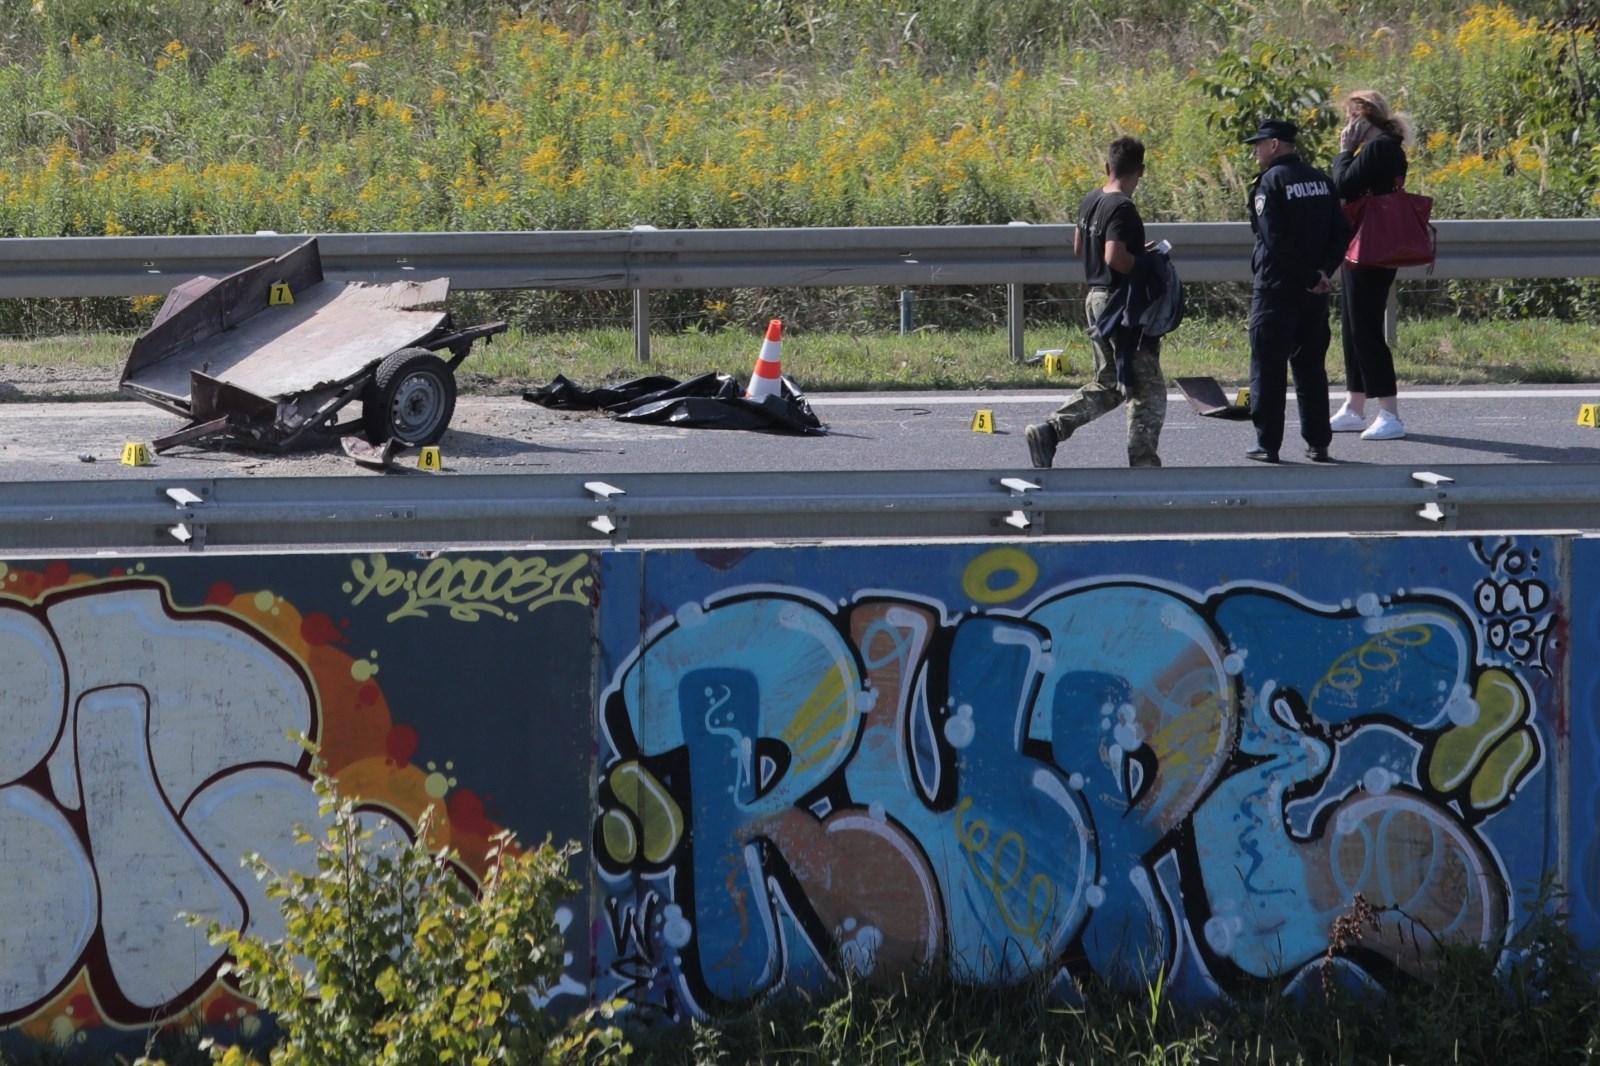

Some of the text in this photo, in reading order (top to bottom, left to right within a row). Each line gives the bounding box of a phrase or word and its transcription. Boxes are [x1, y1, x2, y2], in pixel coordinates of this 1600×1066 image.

[1286, 181, 1329, 200] POLICIJA
[276, 288, 283, 302] 7
[1057, 358, 1063, 373] 4
[978, 414, 985, 429] 5
[1583, 408, 1590, 422] 2
[138, 447, 145, 462] 9
[425, 451, 432, 466] 8
[1474, 577, 1550, 617] OCD
